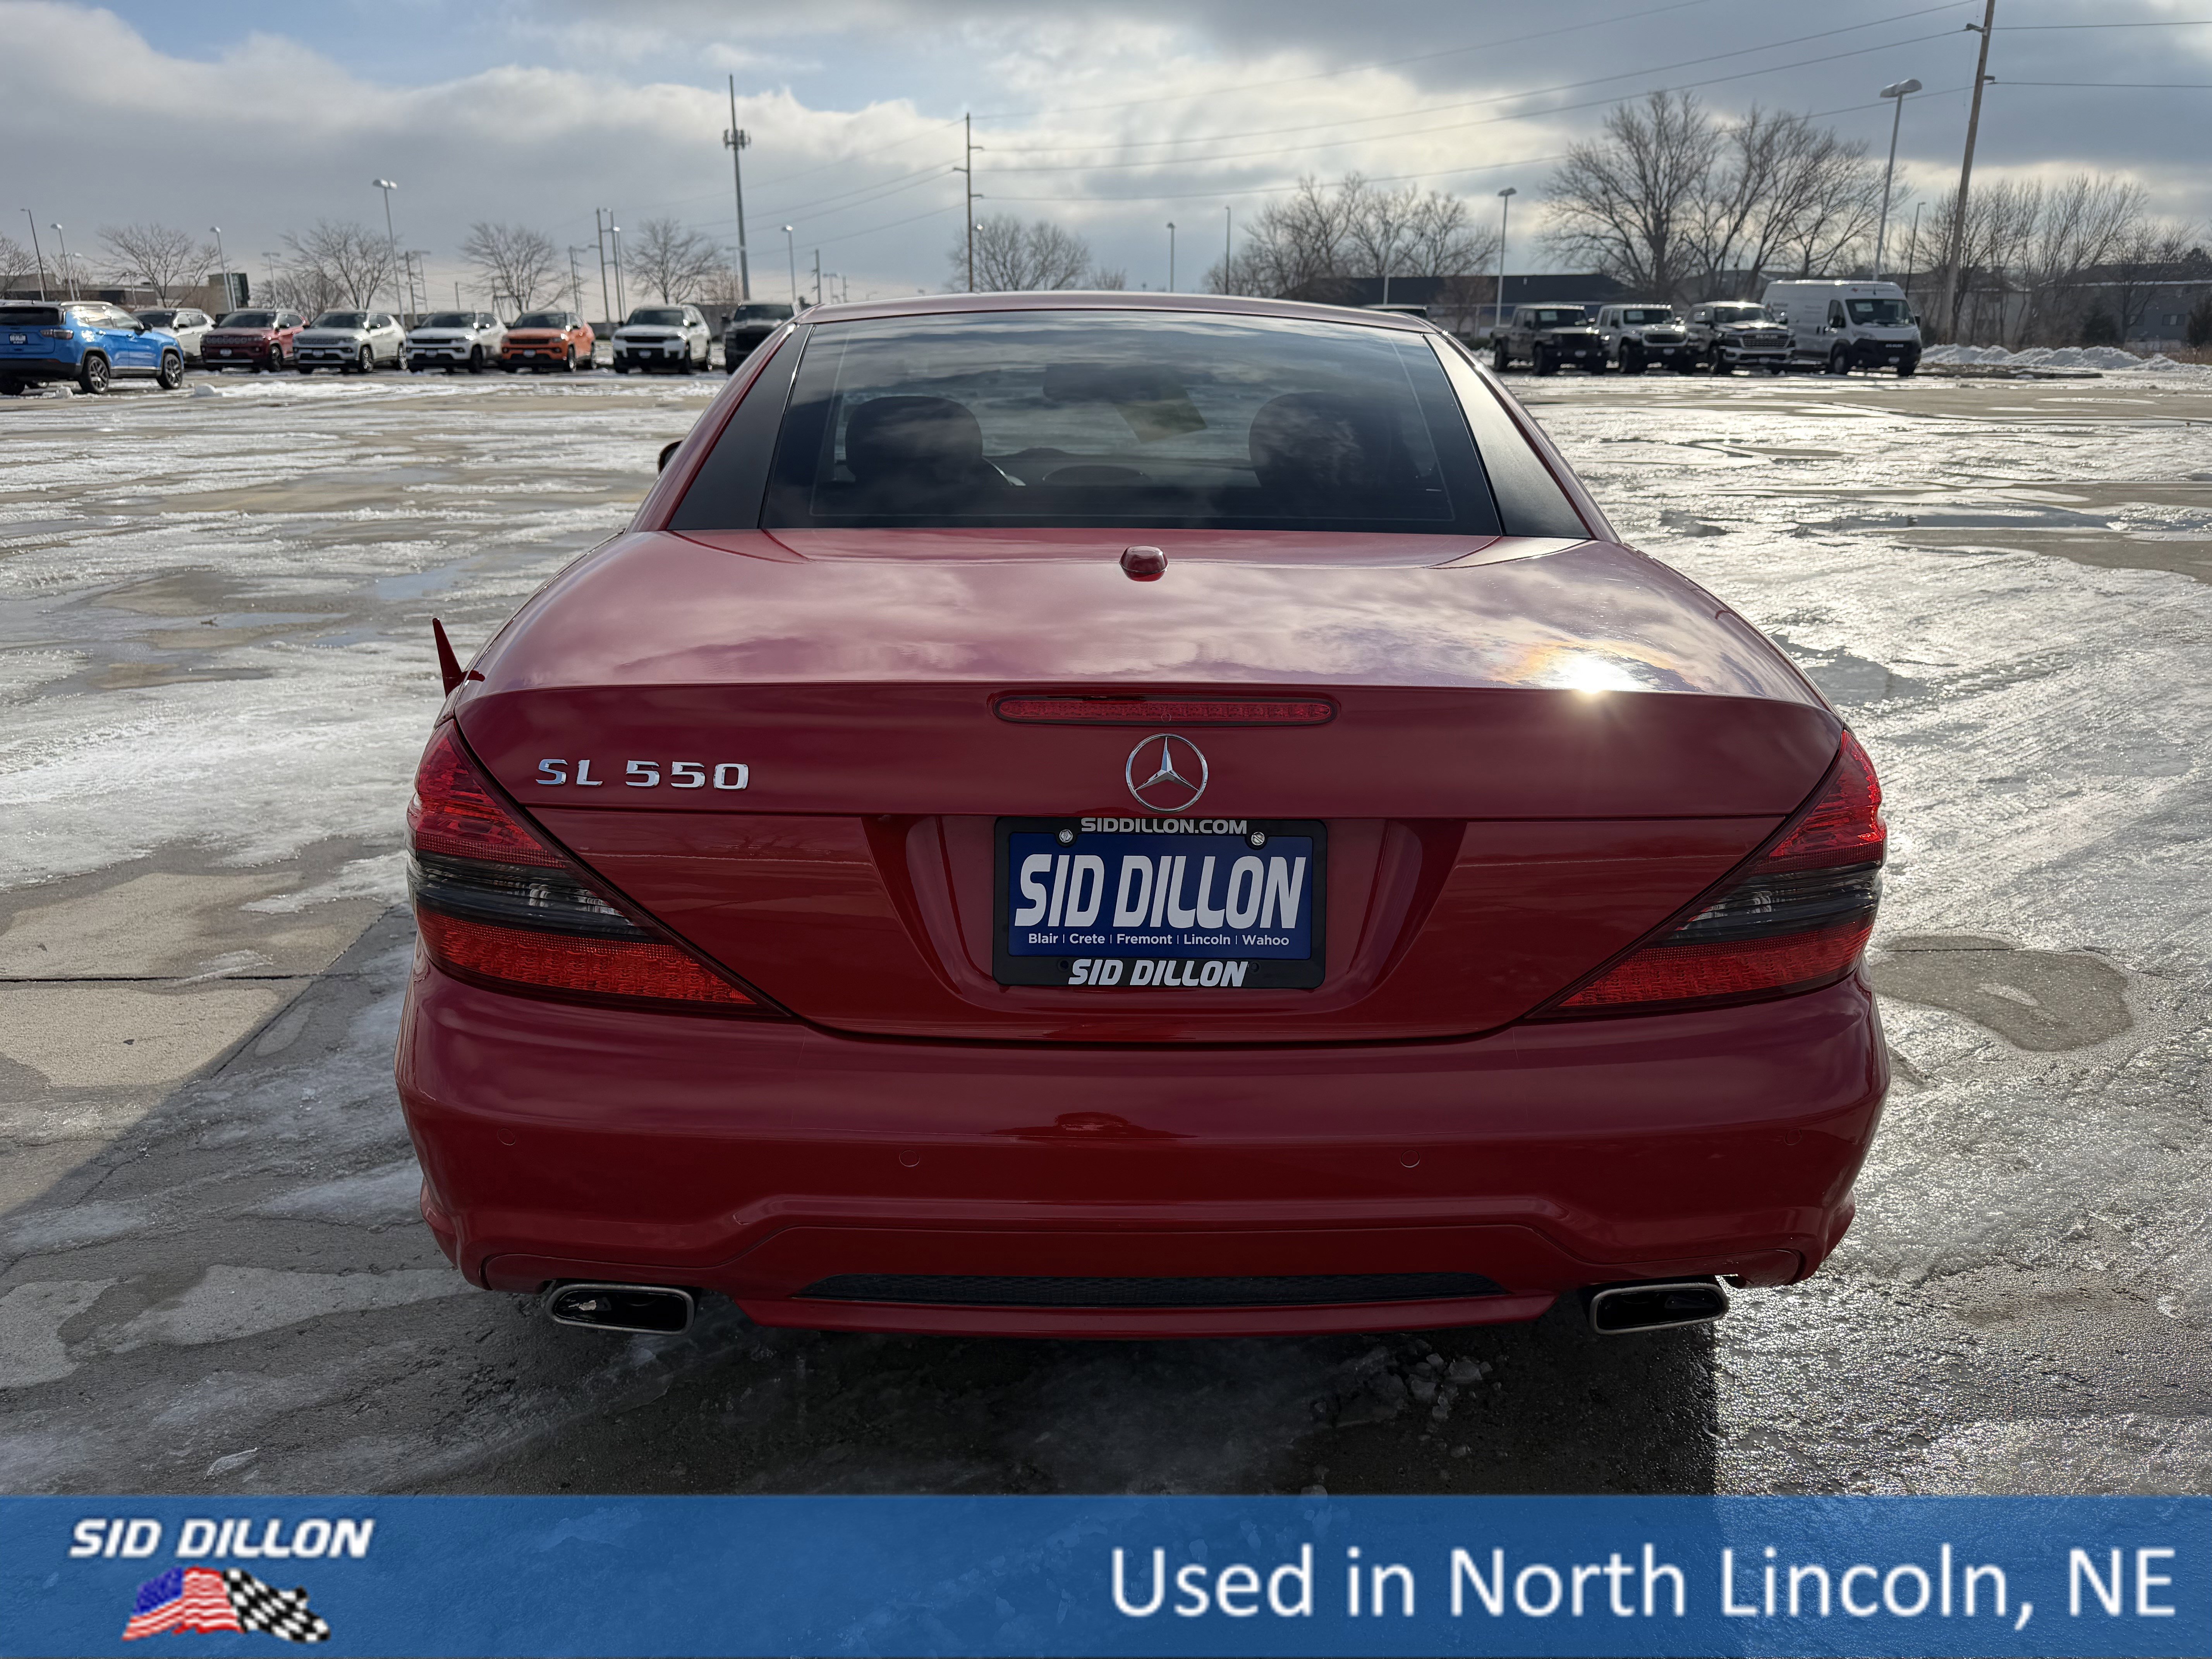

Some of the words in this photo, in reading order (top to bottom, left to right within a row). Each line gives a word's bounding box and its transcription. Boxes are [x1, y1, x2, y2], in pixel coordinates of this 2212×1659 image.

[536, 759, 603, 786] SL
[625, 760, 749, 789] 550
[1081, 817, 1247, 835] SIDDILLON.COM
[1015, 854, 1105, 927] SID
[1113, 855, 1307, 929] DILLON
[1028, 933, 1058, 944] Blair
[1069, 933, 1106, 944] Crete
[1116, 933, 1173, 945] Fremont
[1184, 934, 1231, 945] Lincoln
[1242, 934, 1290, 946] Wahoo
[1068, 959, 1123, 986] SID
[1130, 960, 1249, 987] DILLON
